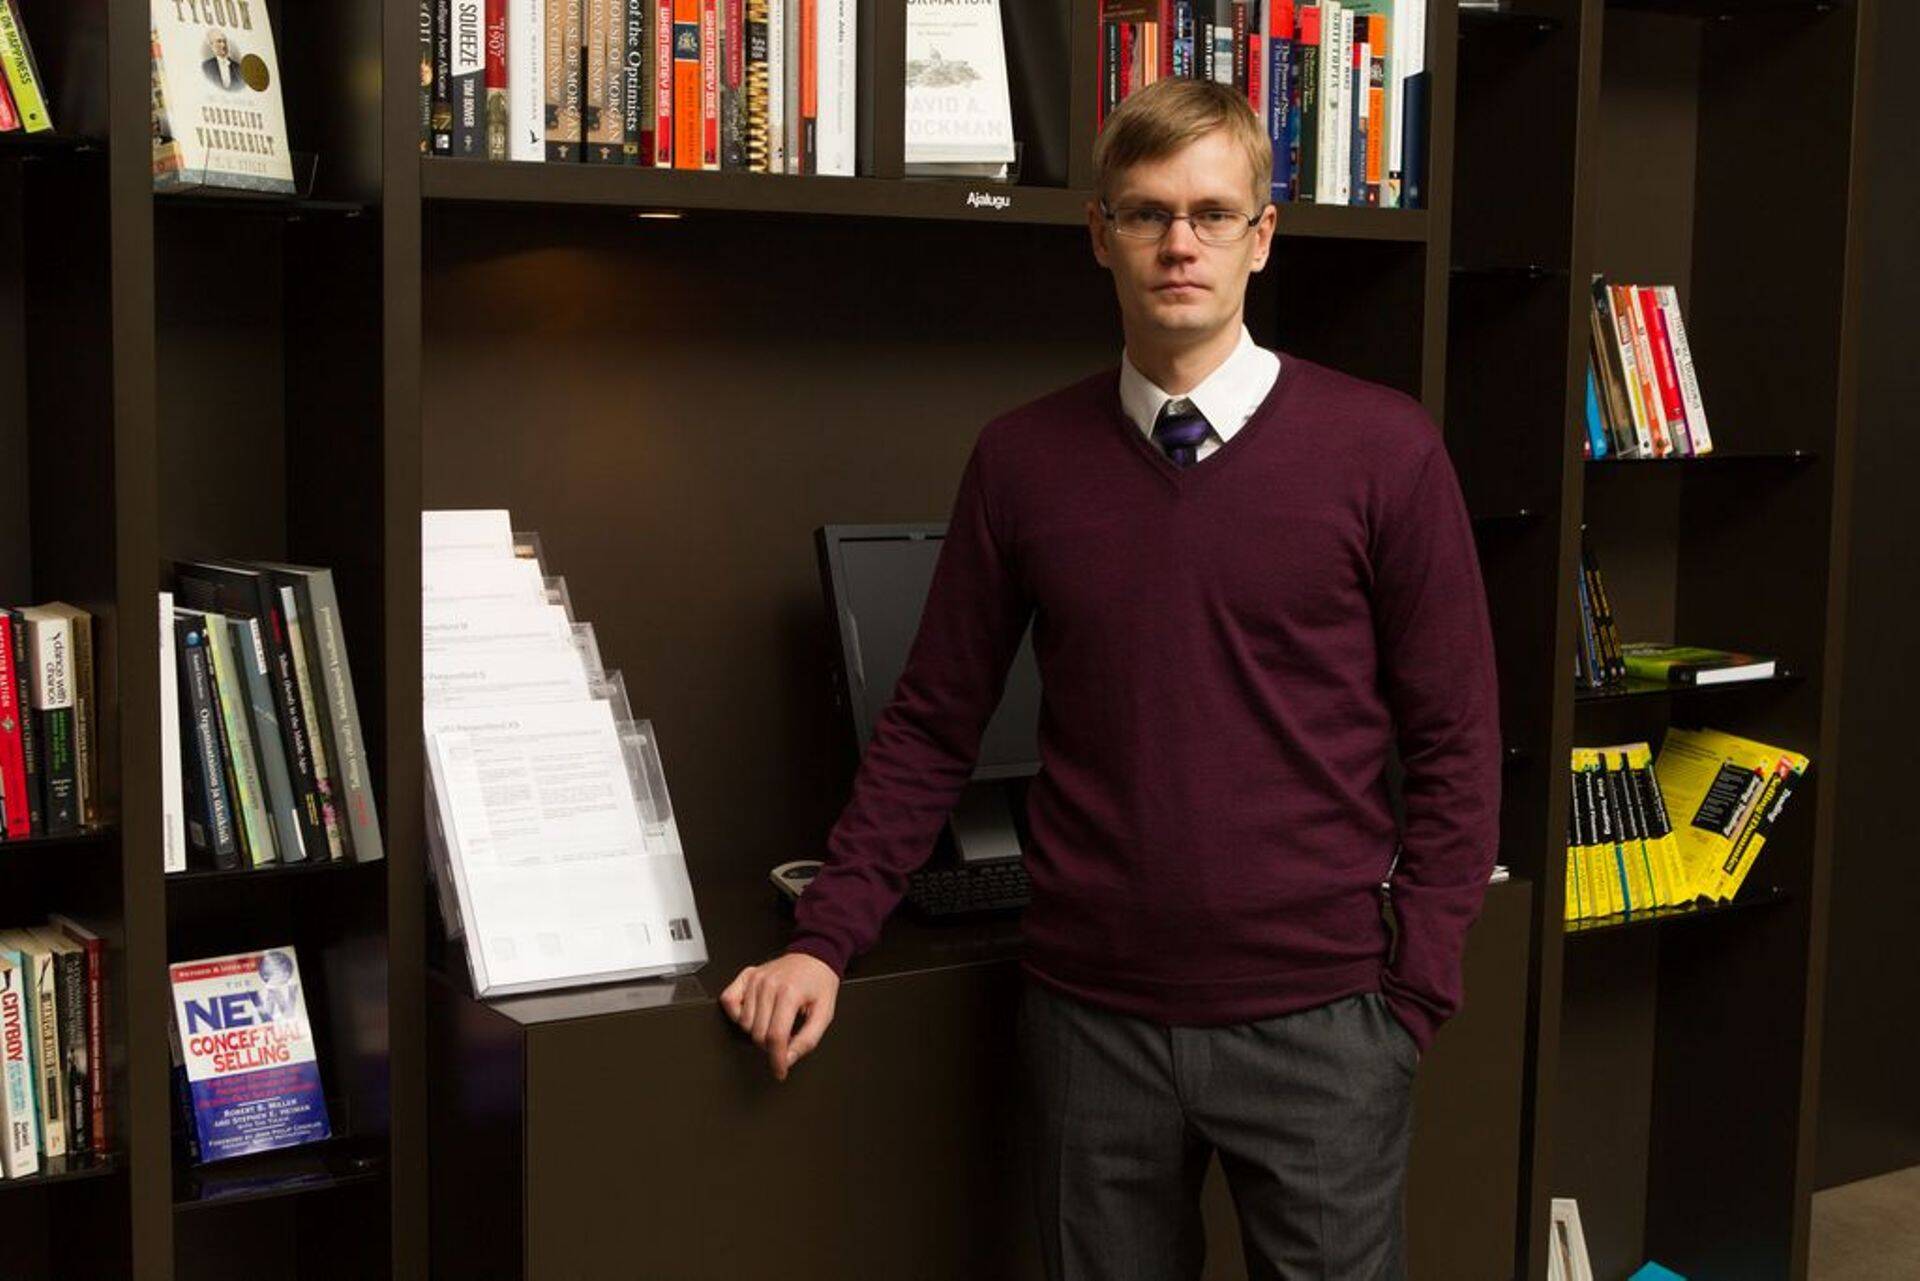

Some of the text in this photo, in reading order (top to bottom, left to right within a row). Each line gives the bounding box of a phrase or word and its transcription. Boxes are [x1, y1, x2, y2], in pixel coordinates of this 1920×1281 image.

[173, 0, 252, 30] TYCOON
[459, 3, 478, 67] SQUEEZE
[628, 21, 641, 46] the
[488, 24, 501, 57] 1907
[608, 72, 621, 141] MORGAN
[624, 51, 642, 132] Optimists
[966, 192, 1010, 210] Ajalugu
[46, 661, 56, 705] chance
[54, 641, 66, 704] dance with
[1600, 799, 1612, 835] Trading
[1767, 787, 1793, 824] Trading
[2, 993, 22, 1061] CITYBOY
[184, 983, 298, 1035] NEW
[213, 1044, 290, 1072] SELLING
